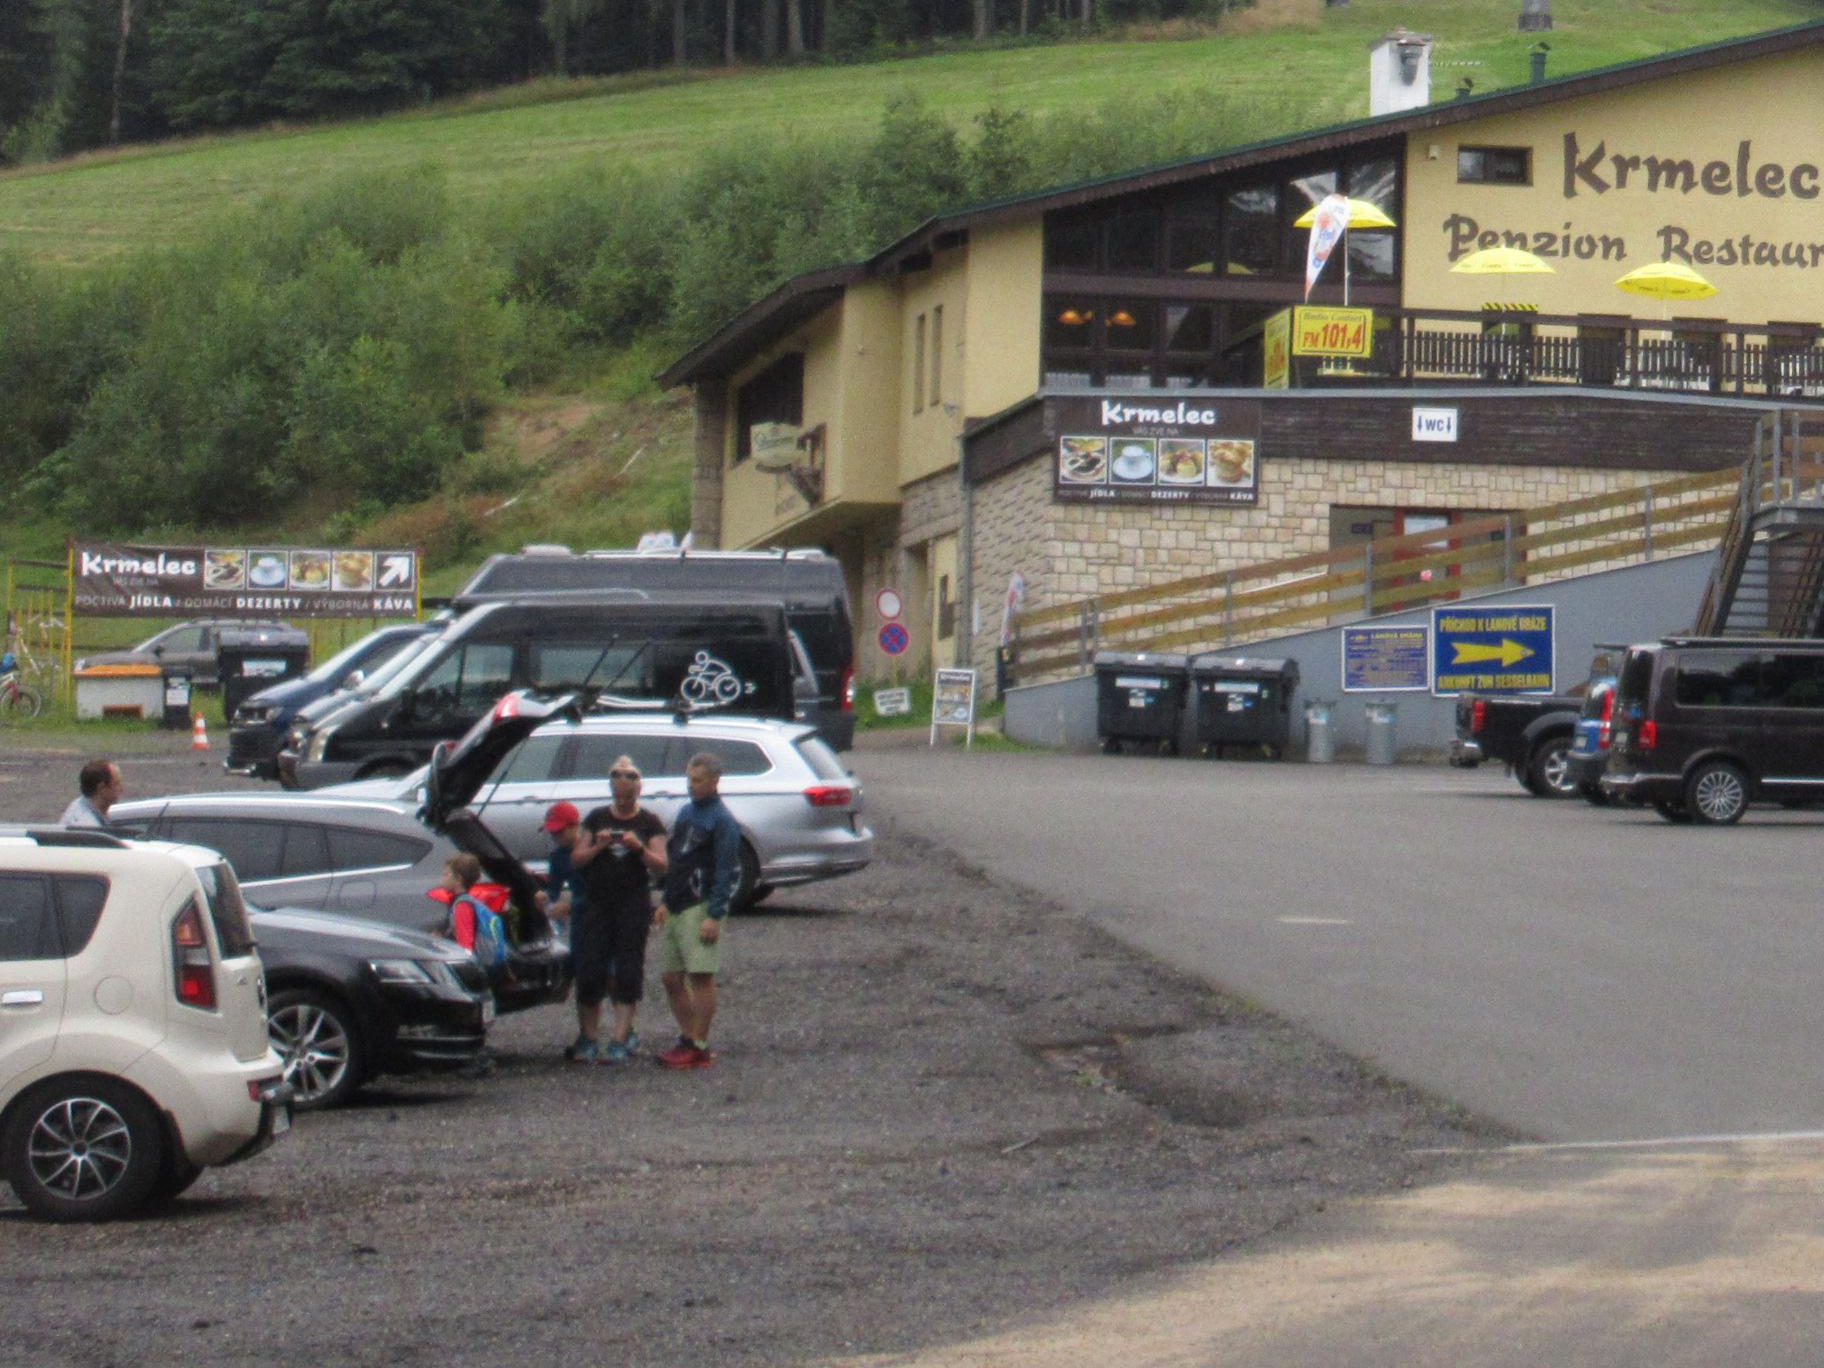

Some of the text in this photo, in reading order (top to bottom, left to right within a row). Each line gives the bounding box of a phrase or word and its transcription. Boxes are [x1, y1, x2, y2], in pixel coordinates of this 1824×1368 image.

[1563, 131, 1822, 200] Krmelec
[1442, 212, 1627, 264] Penzion
[1303, 331, 1321, 348] FM
[1101, 399, 1216, 426] Krmelec
[1425, 419, 1444, 432] WC
[81, 551, 197, 576] Krmelec
[129, 593, 173, 609] JÍDLA
[236, 596, 301, 610] DEZERTY
[373, 596, 414, 611] KÁVA
